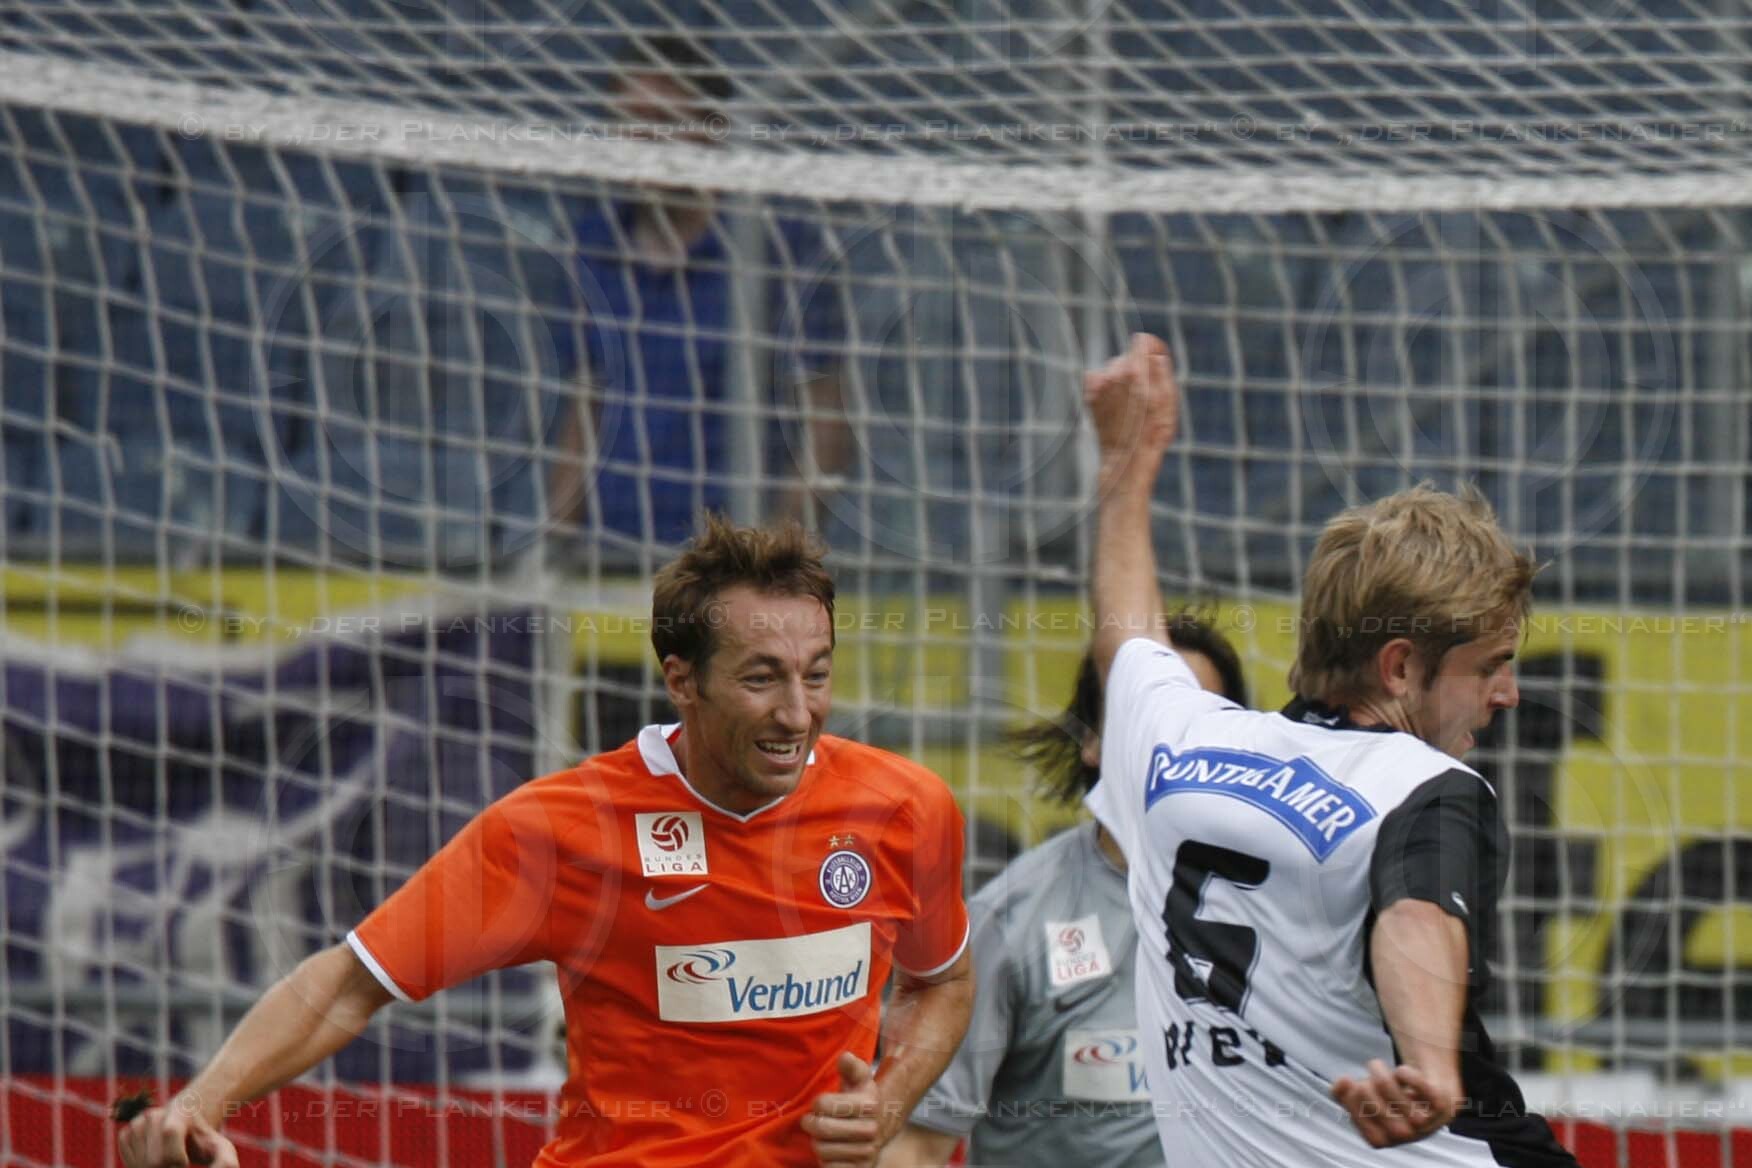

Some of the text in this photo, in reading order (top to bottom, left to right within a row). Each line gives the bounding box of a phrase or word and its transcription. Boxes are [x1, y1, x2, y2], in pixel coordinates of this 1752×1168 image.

[646, 862, 703, 874] LIGA
[1161, 838, 1271, 1019] 6
[726, 960, 861, 1013] Verbund
[1057, 963, 1102, 982] LIGA
